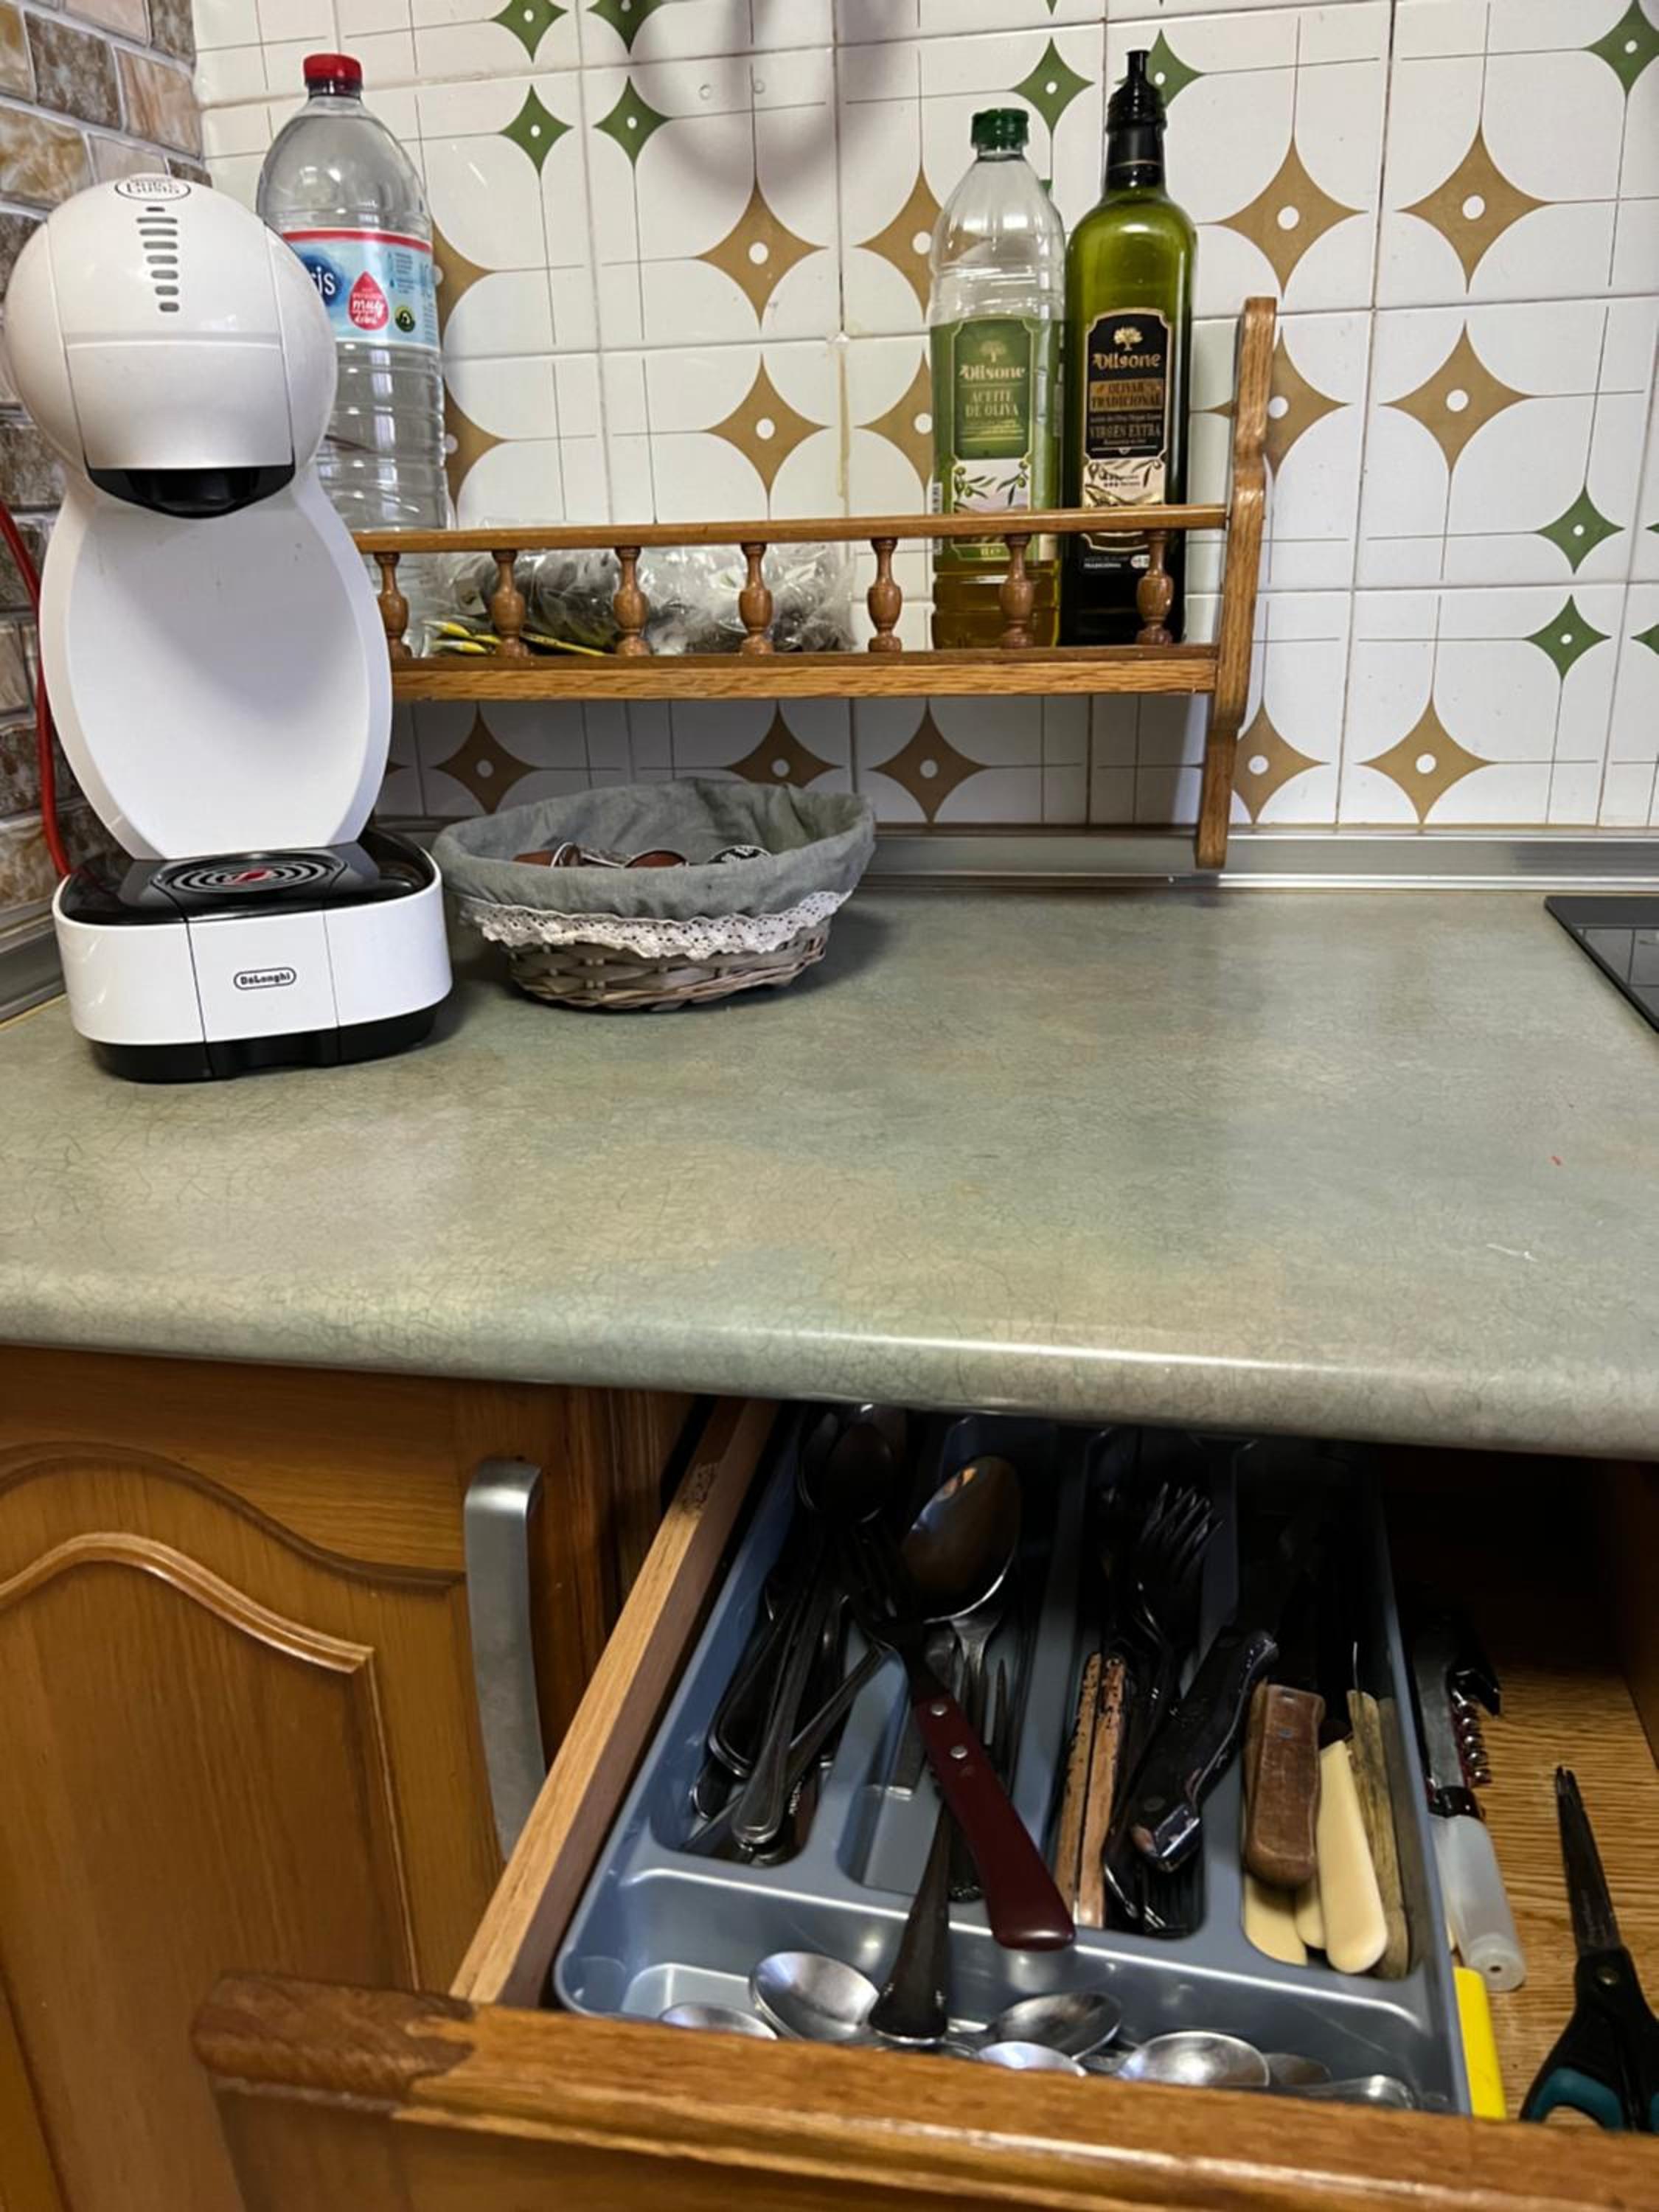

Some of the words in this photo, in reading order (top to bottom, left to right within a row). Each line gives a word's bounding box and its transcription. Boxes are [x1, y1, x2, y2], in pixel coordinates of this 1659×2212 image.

[971, 389, 1013, 403] ACEITE
[964, 405, 981, 417] DE
[984, 403, 1019, 417] OLIVA
